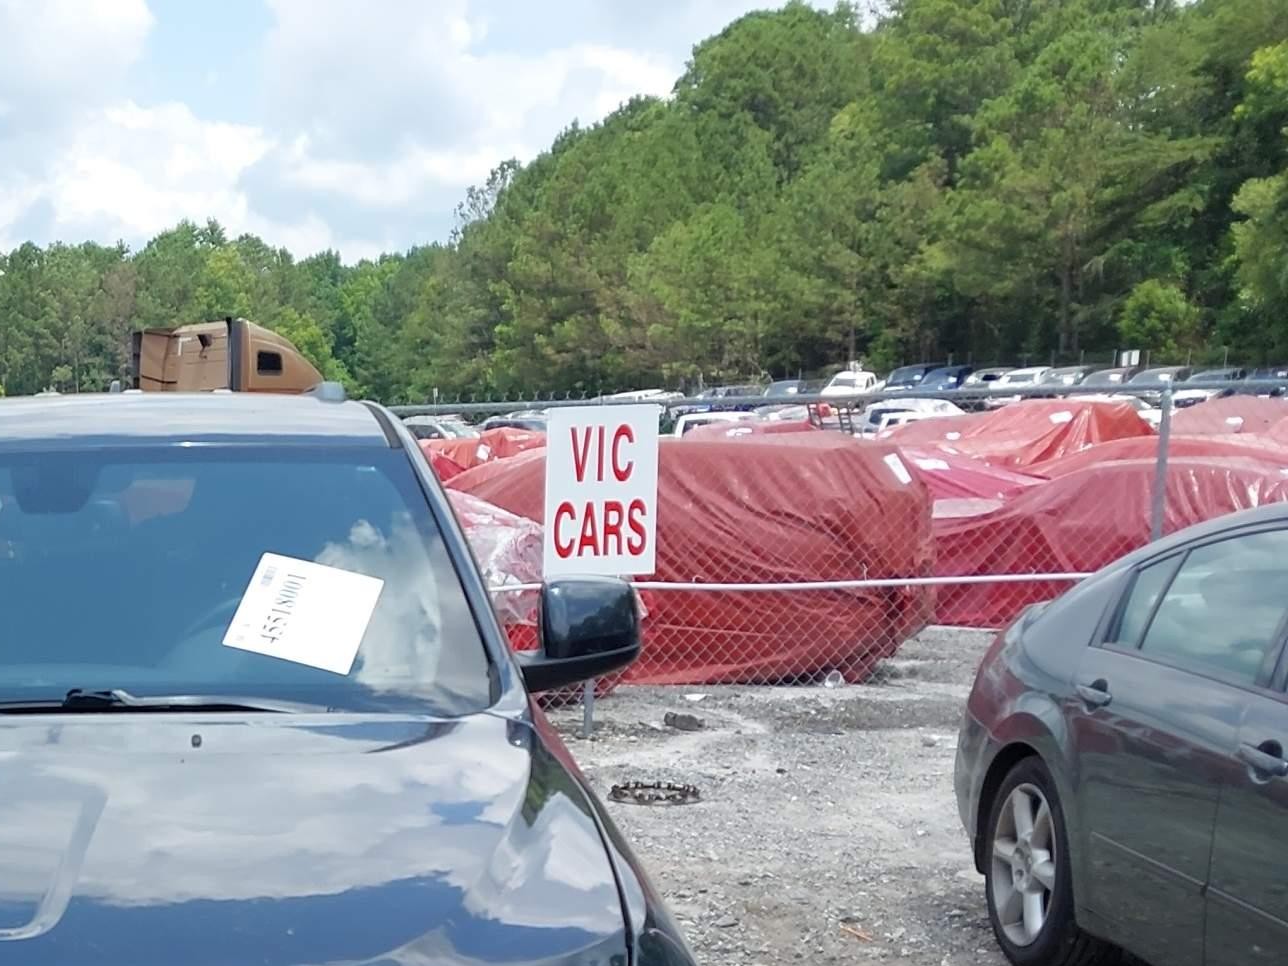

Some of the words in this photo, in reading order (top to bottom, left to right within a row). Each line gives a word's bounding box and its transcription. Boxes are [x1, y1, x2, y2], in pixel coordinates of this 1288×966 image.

[570, 424, 635, 482] VIC
[553, 498, 647, 559] CARS
[260, 573, 307, 643] 45518001
